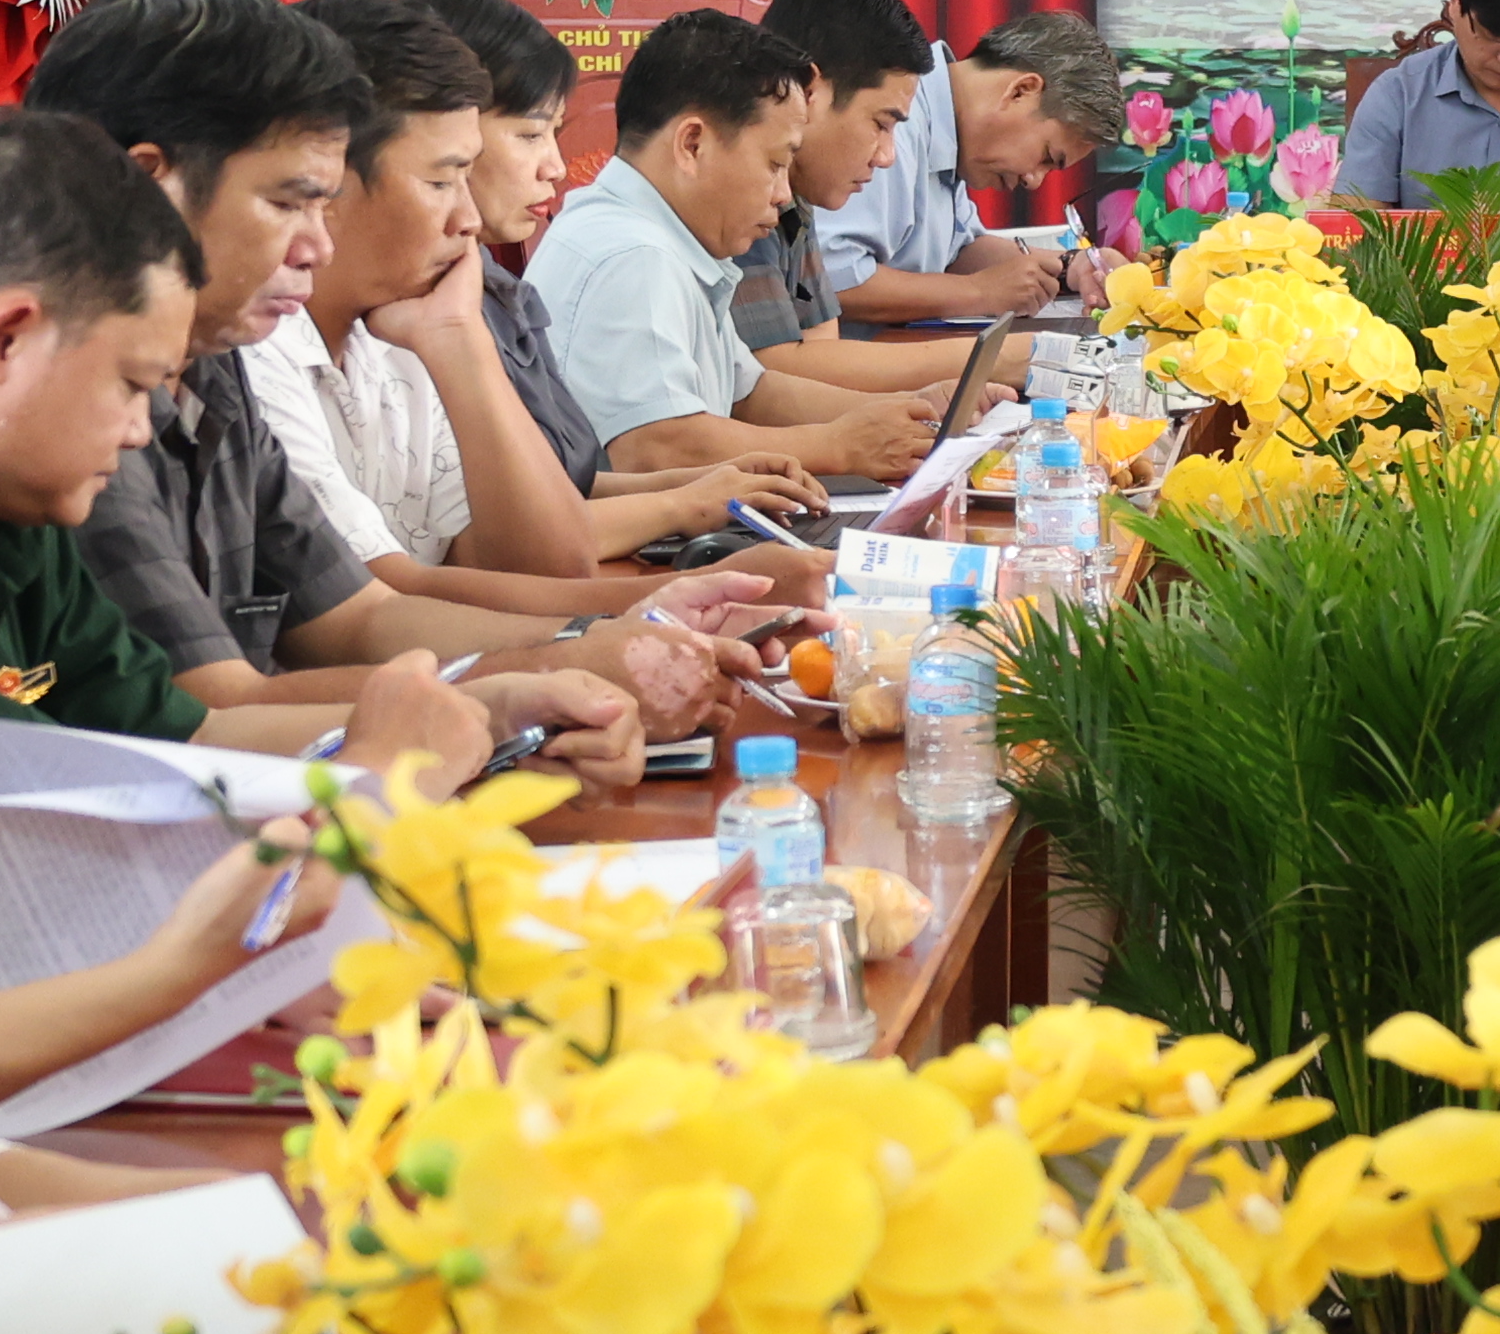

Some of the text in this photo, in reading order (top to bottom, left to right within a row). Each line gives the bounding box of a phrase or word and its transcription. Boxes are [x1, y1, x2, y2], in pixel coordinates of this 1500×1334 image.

[557, 24, 611, 47] CHỦ
[578, 52, 622, 72] CHÍ
[861, 540, 877, 572] Dalat
